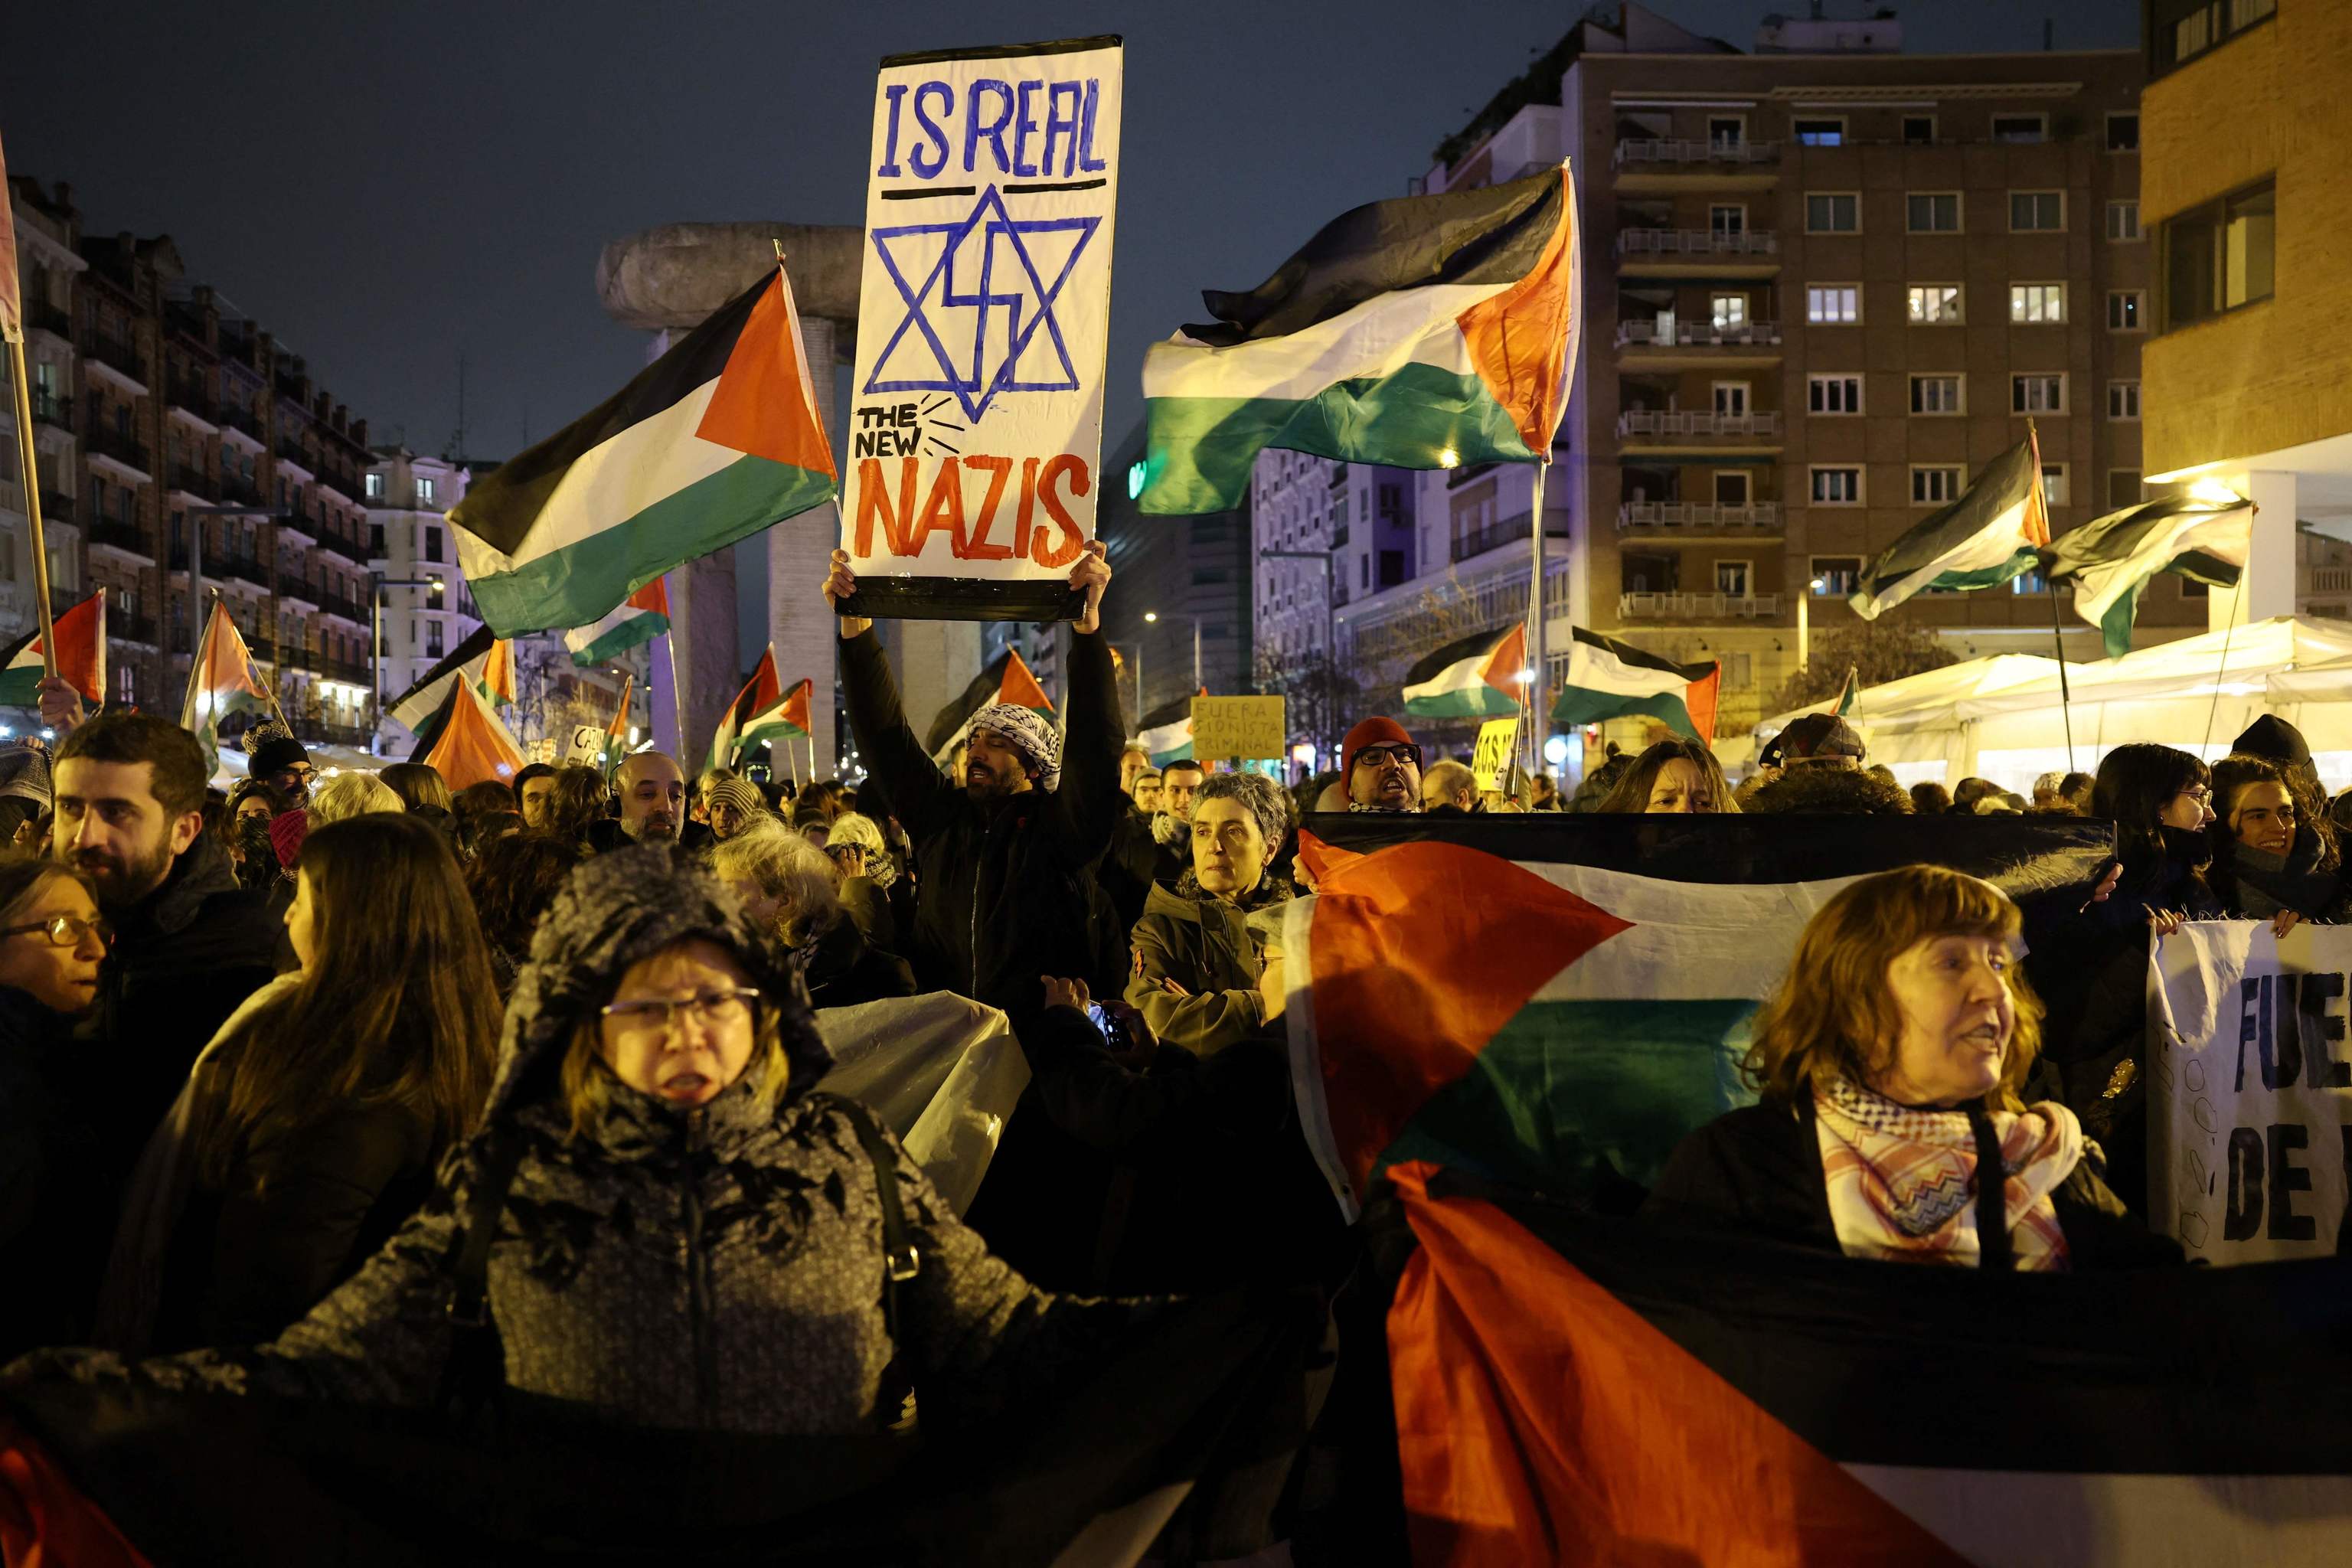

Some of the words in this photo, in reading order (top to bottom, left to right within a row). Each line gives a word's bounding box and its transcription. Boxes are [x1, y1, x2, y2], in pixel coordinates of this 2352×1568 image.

[854, 403, 919, 429] THE
[855, 427, 922, 459] NEW
[854, 454, 1091, 568] NAZIS
[1195, 702, 1267, 720] FUERA
[1194, 720, 1279, 736] SIONISTA
[1195, 737, 1272, 752] CRIMINAL
[2234, 972, 2352, 1093] FUE
[2223, 1124, 2316, 1241] DE
